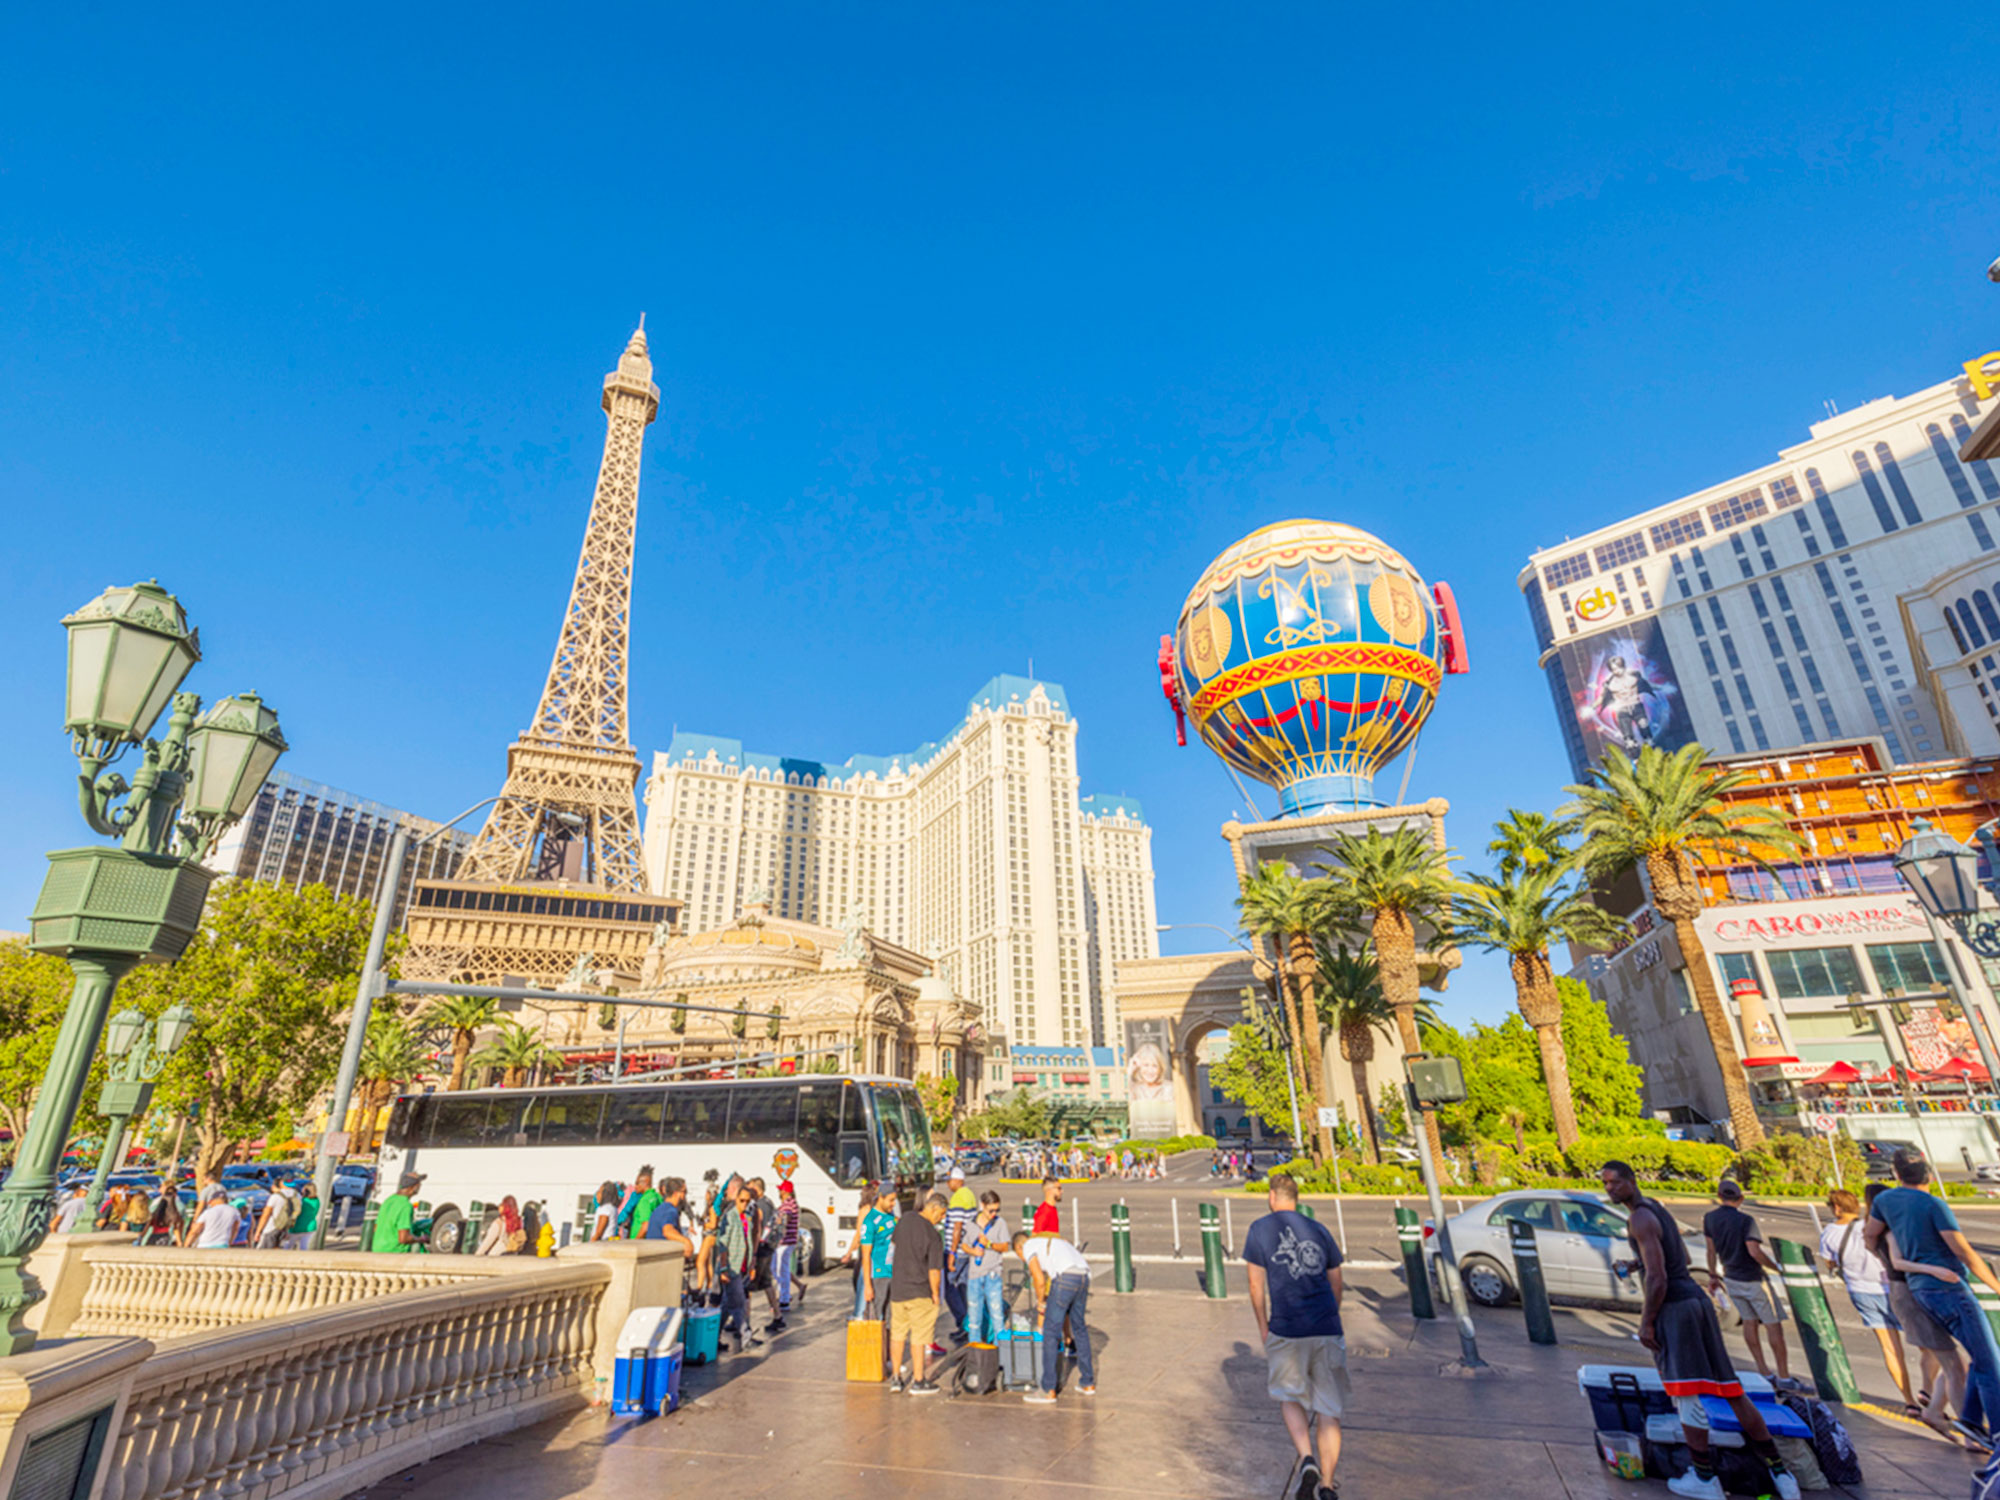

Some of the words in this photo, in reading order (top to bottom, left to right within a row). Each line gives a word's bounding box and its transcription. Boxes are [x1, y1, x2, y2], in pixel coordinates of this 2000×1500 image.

[1579, 587, 1617, 619] ph
[1715, 912, 1823, 942] CABO
[1820, 906, 1903, 928] WABO
[1783, 1064, 1818, 1075] CABO
